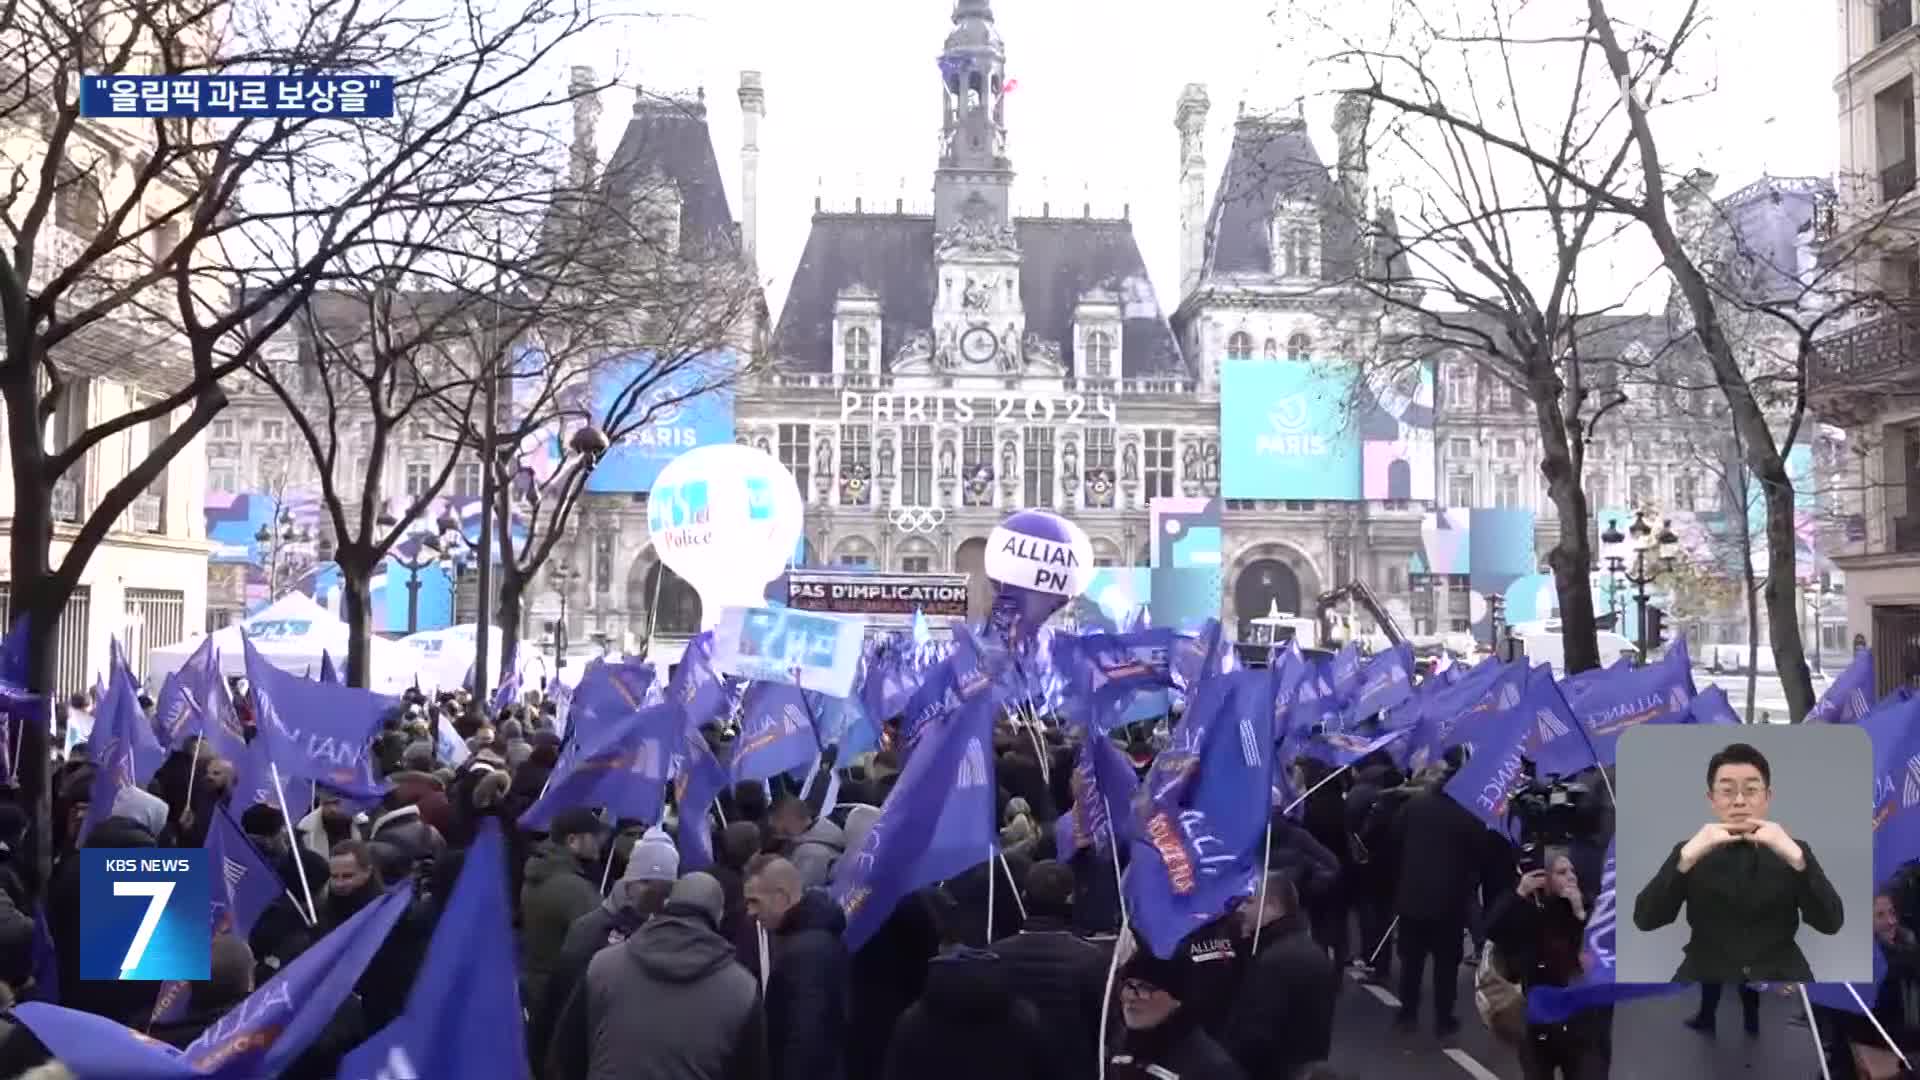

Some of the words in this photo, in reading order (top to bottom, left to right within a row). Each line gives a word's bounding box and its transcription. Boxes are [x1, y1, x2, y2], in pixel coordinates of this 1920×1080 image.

[840, 391, 974, 424] PARIS
[994, 394, 1116, 424] 2024
[789, 583, 825, 598] PAS
[831, 584, 967, 601] D'IMPLICATION
[1034, 568, 1068, 592] PN
